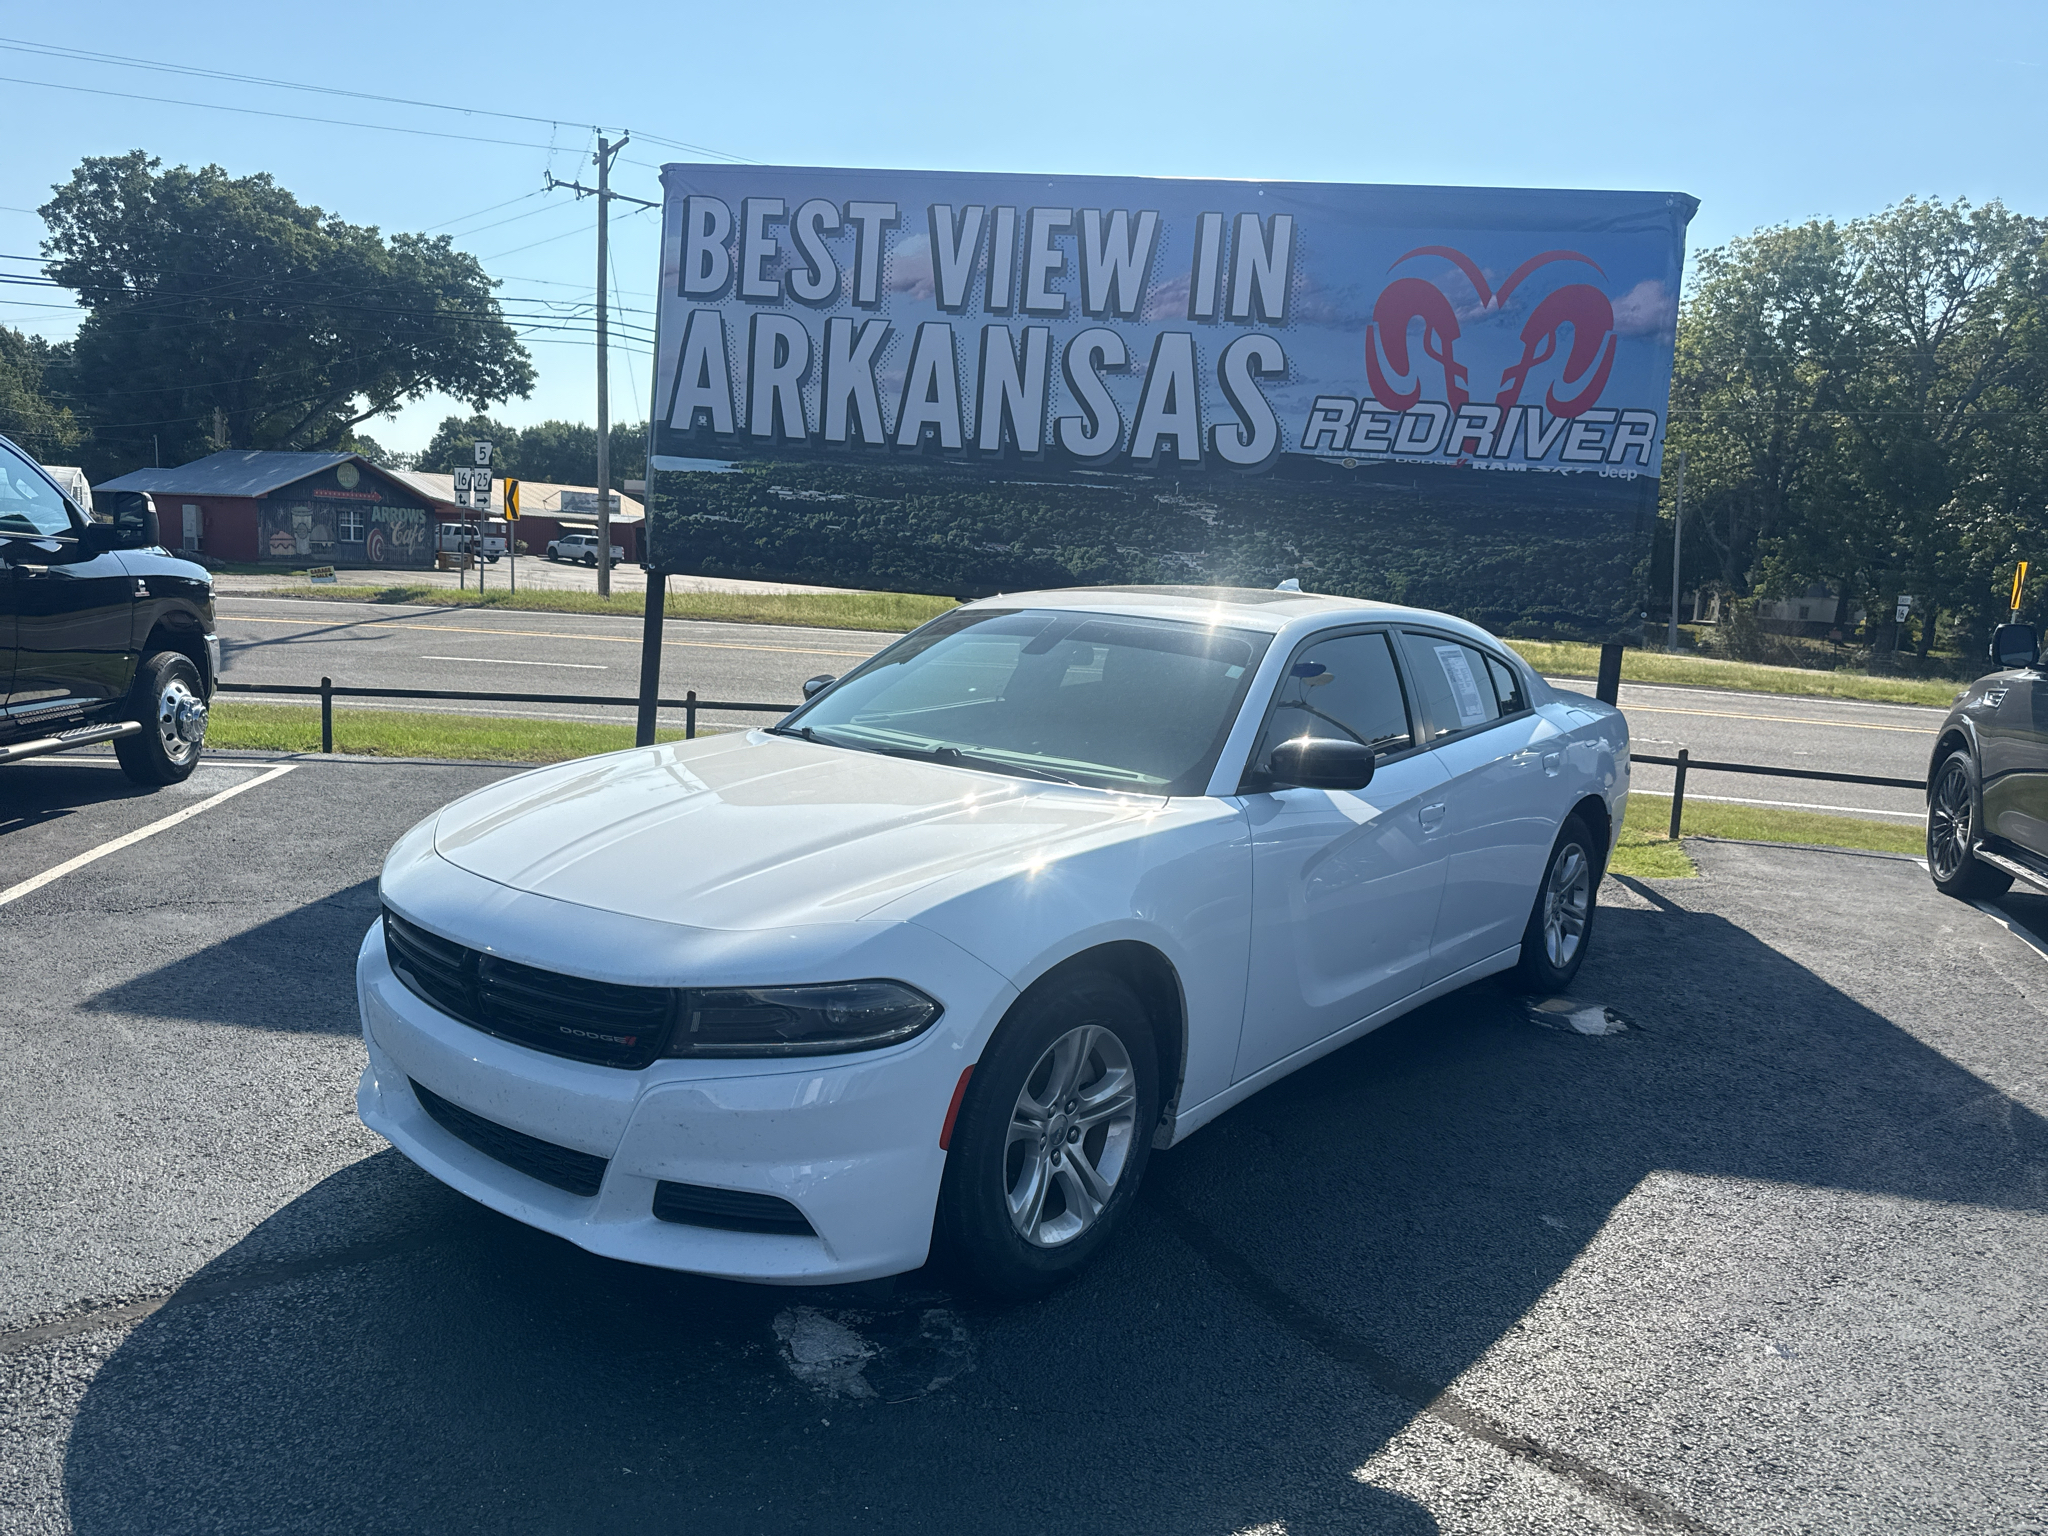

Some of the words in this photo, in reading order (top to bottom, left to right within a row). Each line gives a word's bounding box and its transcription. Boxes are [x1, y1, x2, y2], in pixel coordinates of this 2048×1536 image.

[681, 196, 899, 307] BEST
[928, 204, 1160, 315] VIEW
[1191, 211, 1295, 321] IN
[667, 309, 1287, 466] ARKANSAS
[1301, 396, 1658, 465] REDRIVER
[479, 446, 487, 460] 5
[1314, 450, 1388, 460] CHRYSLER
[1395, 457, 1458, 467] DODGE
[1472, 461, 1528, 472] RAM
[1531, 465, 1593, 477] SRT
[1598, 465, 1638, 481] Jeep
[457, 471, 467, 486] 16
[477, 472, 488, 487] 25
[371, 505, 427, 524] ARROWS
[390, 520, 425, 555] Cafe
[560, 1026, 627, 1044] DODGE
